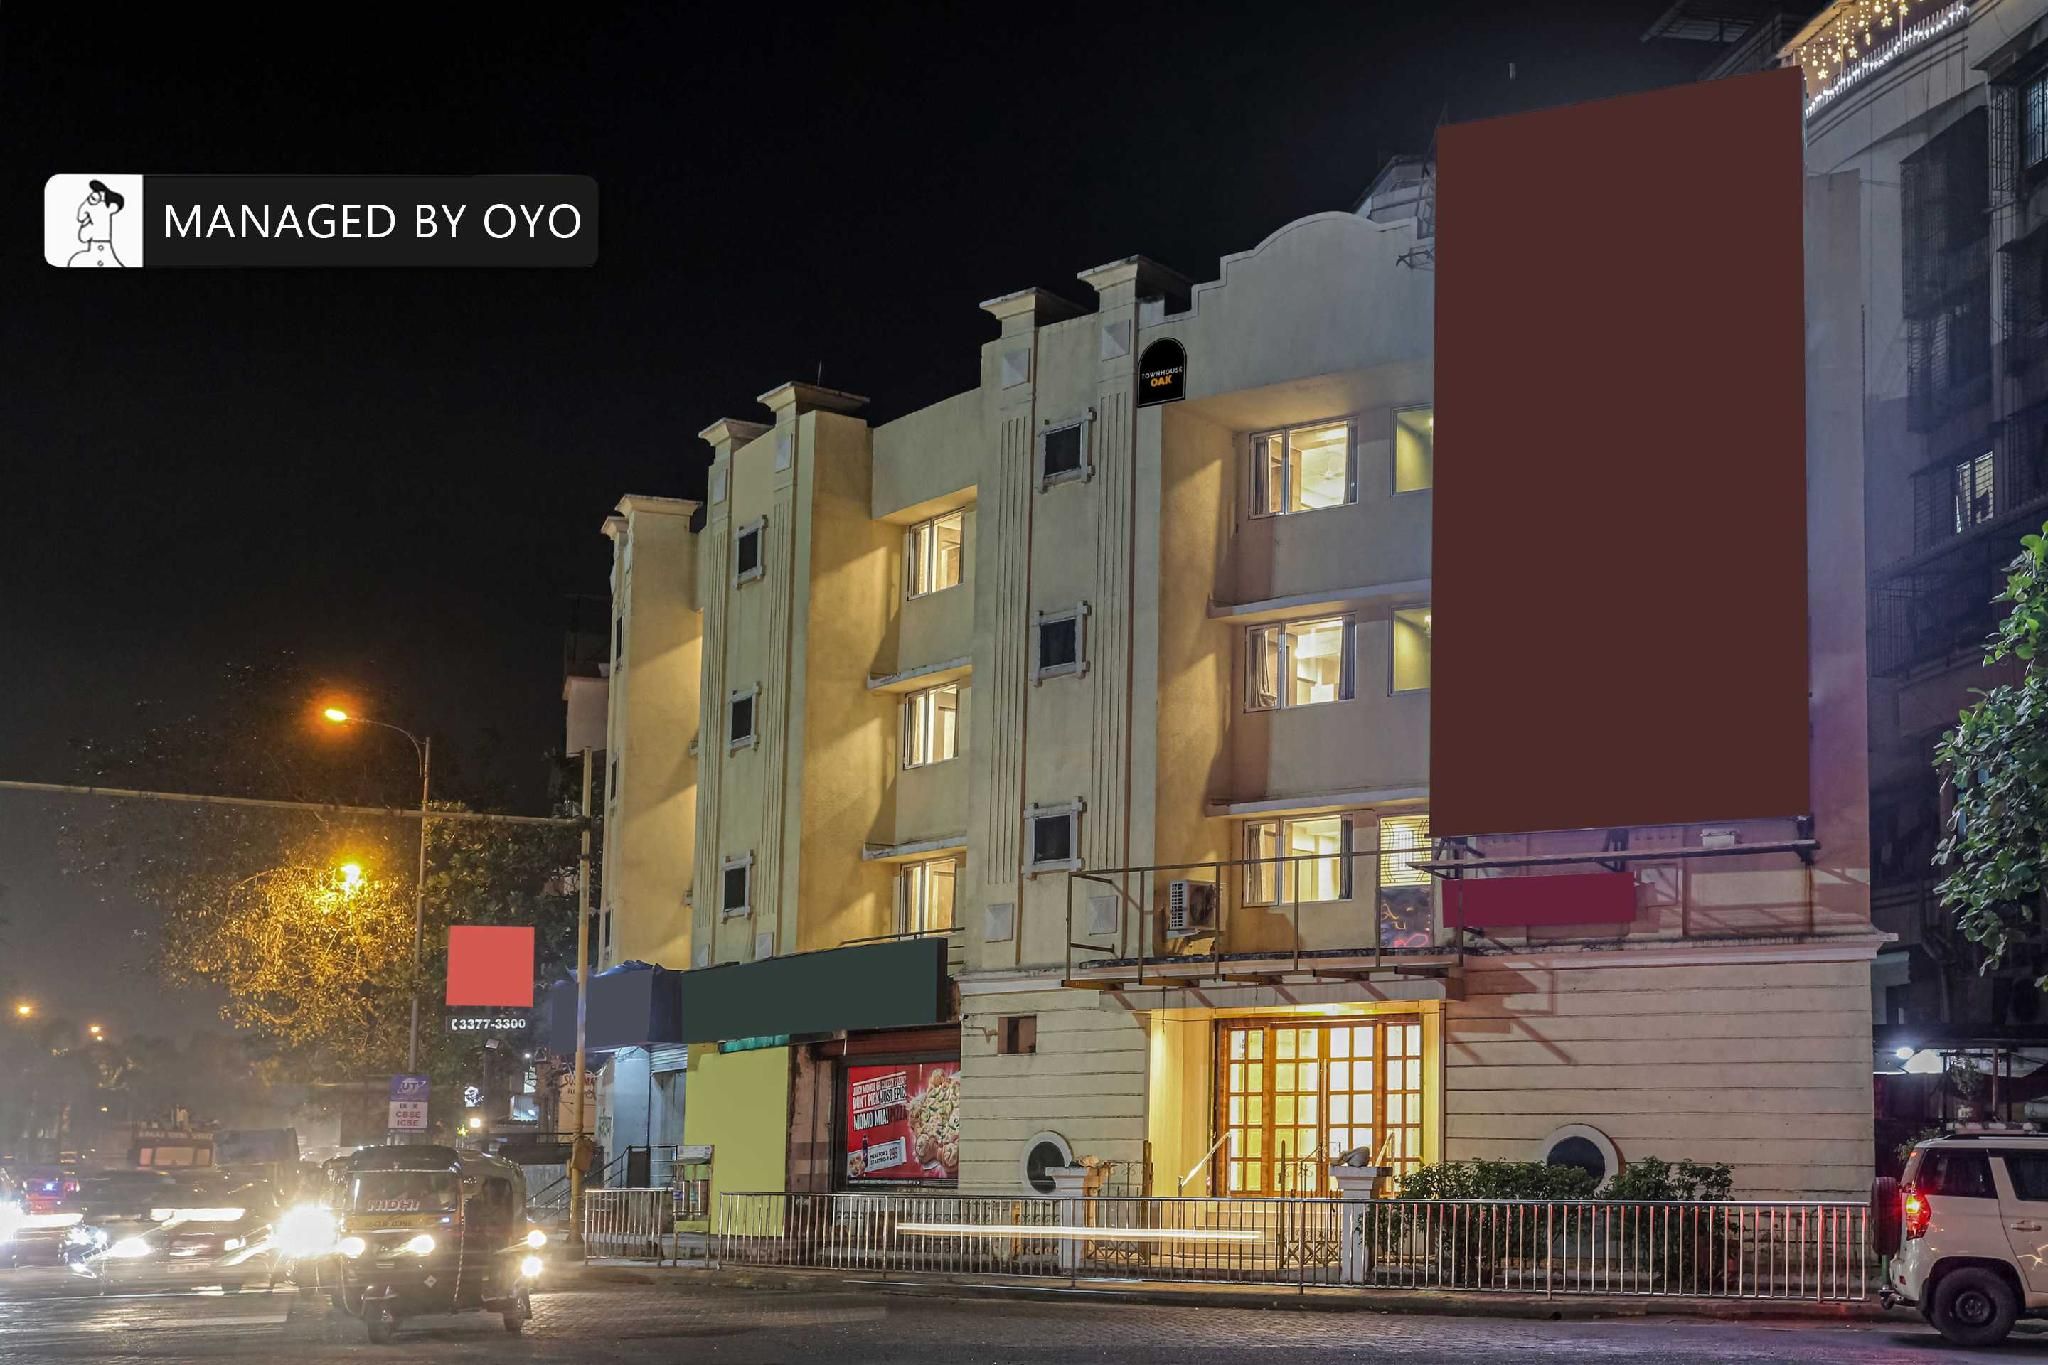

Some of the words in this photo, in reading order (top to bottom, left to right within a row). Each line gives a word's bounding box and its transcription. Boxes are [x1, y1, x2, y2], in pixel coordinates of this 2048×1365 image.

[1151, 375, 1172, 387] OAK
[459, 1018, 526, 1030] 3377-3300
[853, 1111, 873, 1131] MOMO
